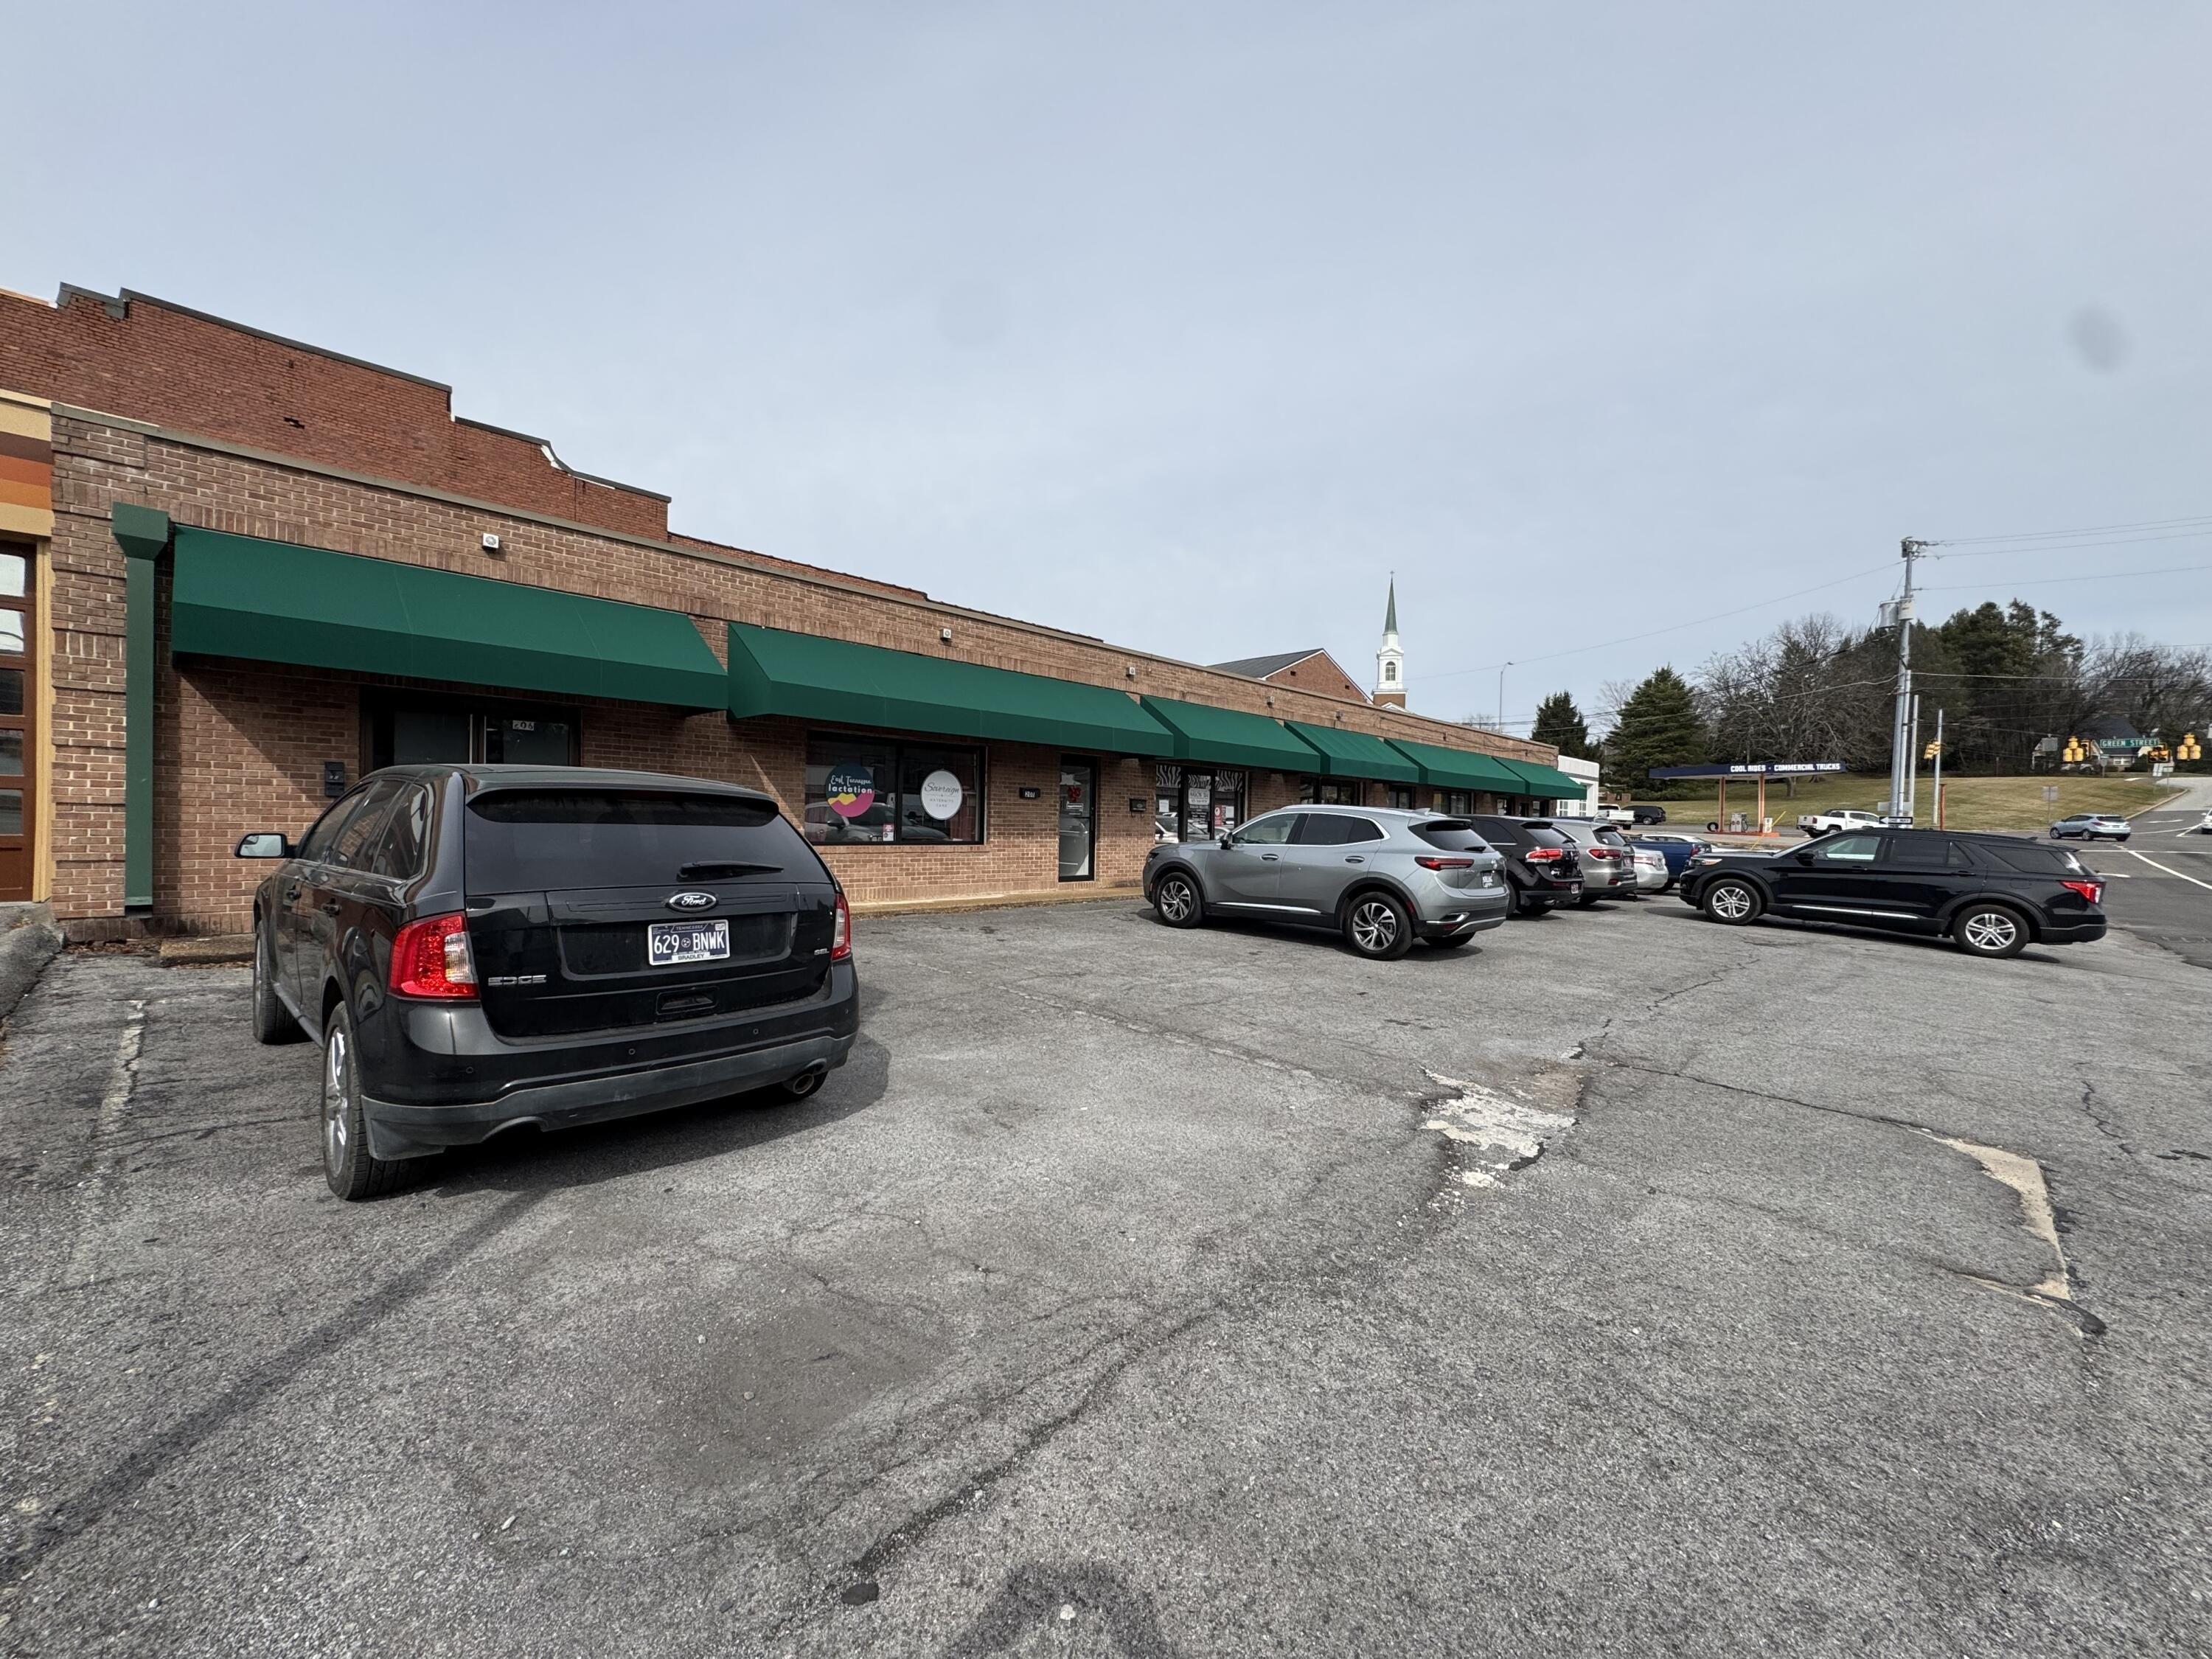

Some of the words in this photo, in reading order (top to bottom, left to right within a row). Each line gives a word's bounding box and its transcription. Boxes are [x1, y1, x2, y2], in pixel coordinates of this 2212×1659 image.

[514, 722, 533, 730] 206
[2102, 740, 2126, 748] GREEN
[830, 774, 844, 785] East
[846, 776, 872, 787] Tennessee
[828, 783, 872, 794] lactation
[924, 782, 959, 795] Sovereign
[681, 895, 707, 906] Ford
[653, 934, 680, 954] 629
[692, 931, 725, 951] BNWK
[488, 975, 547, 987] EDGE
